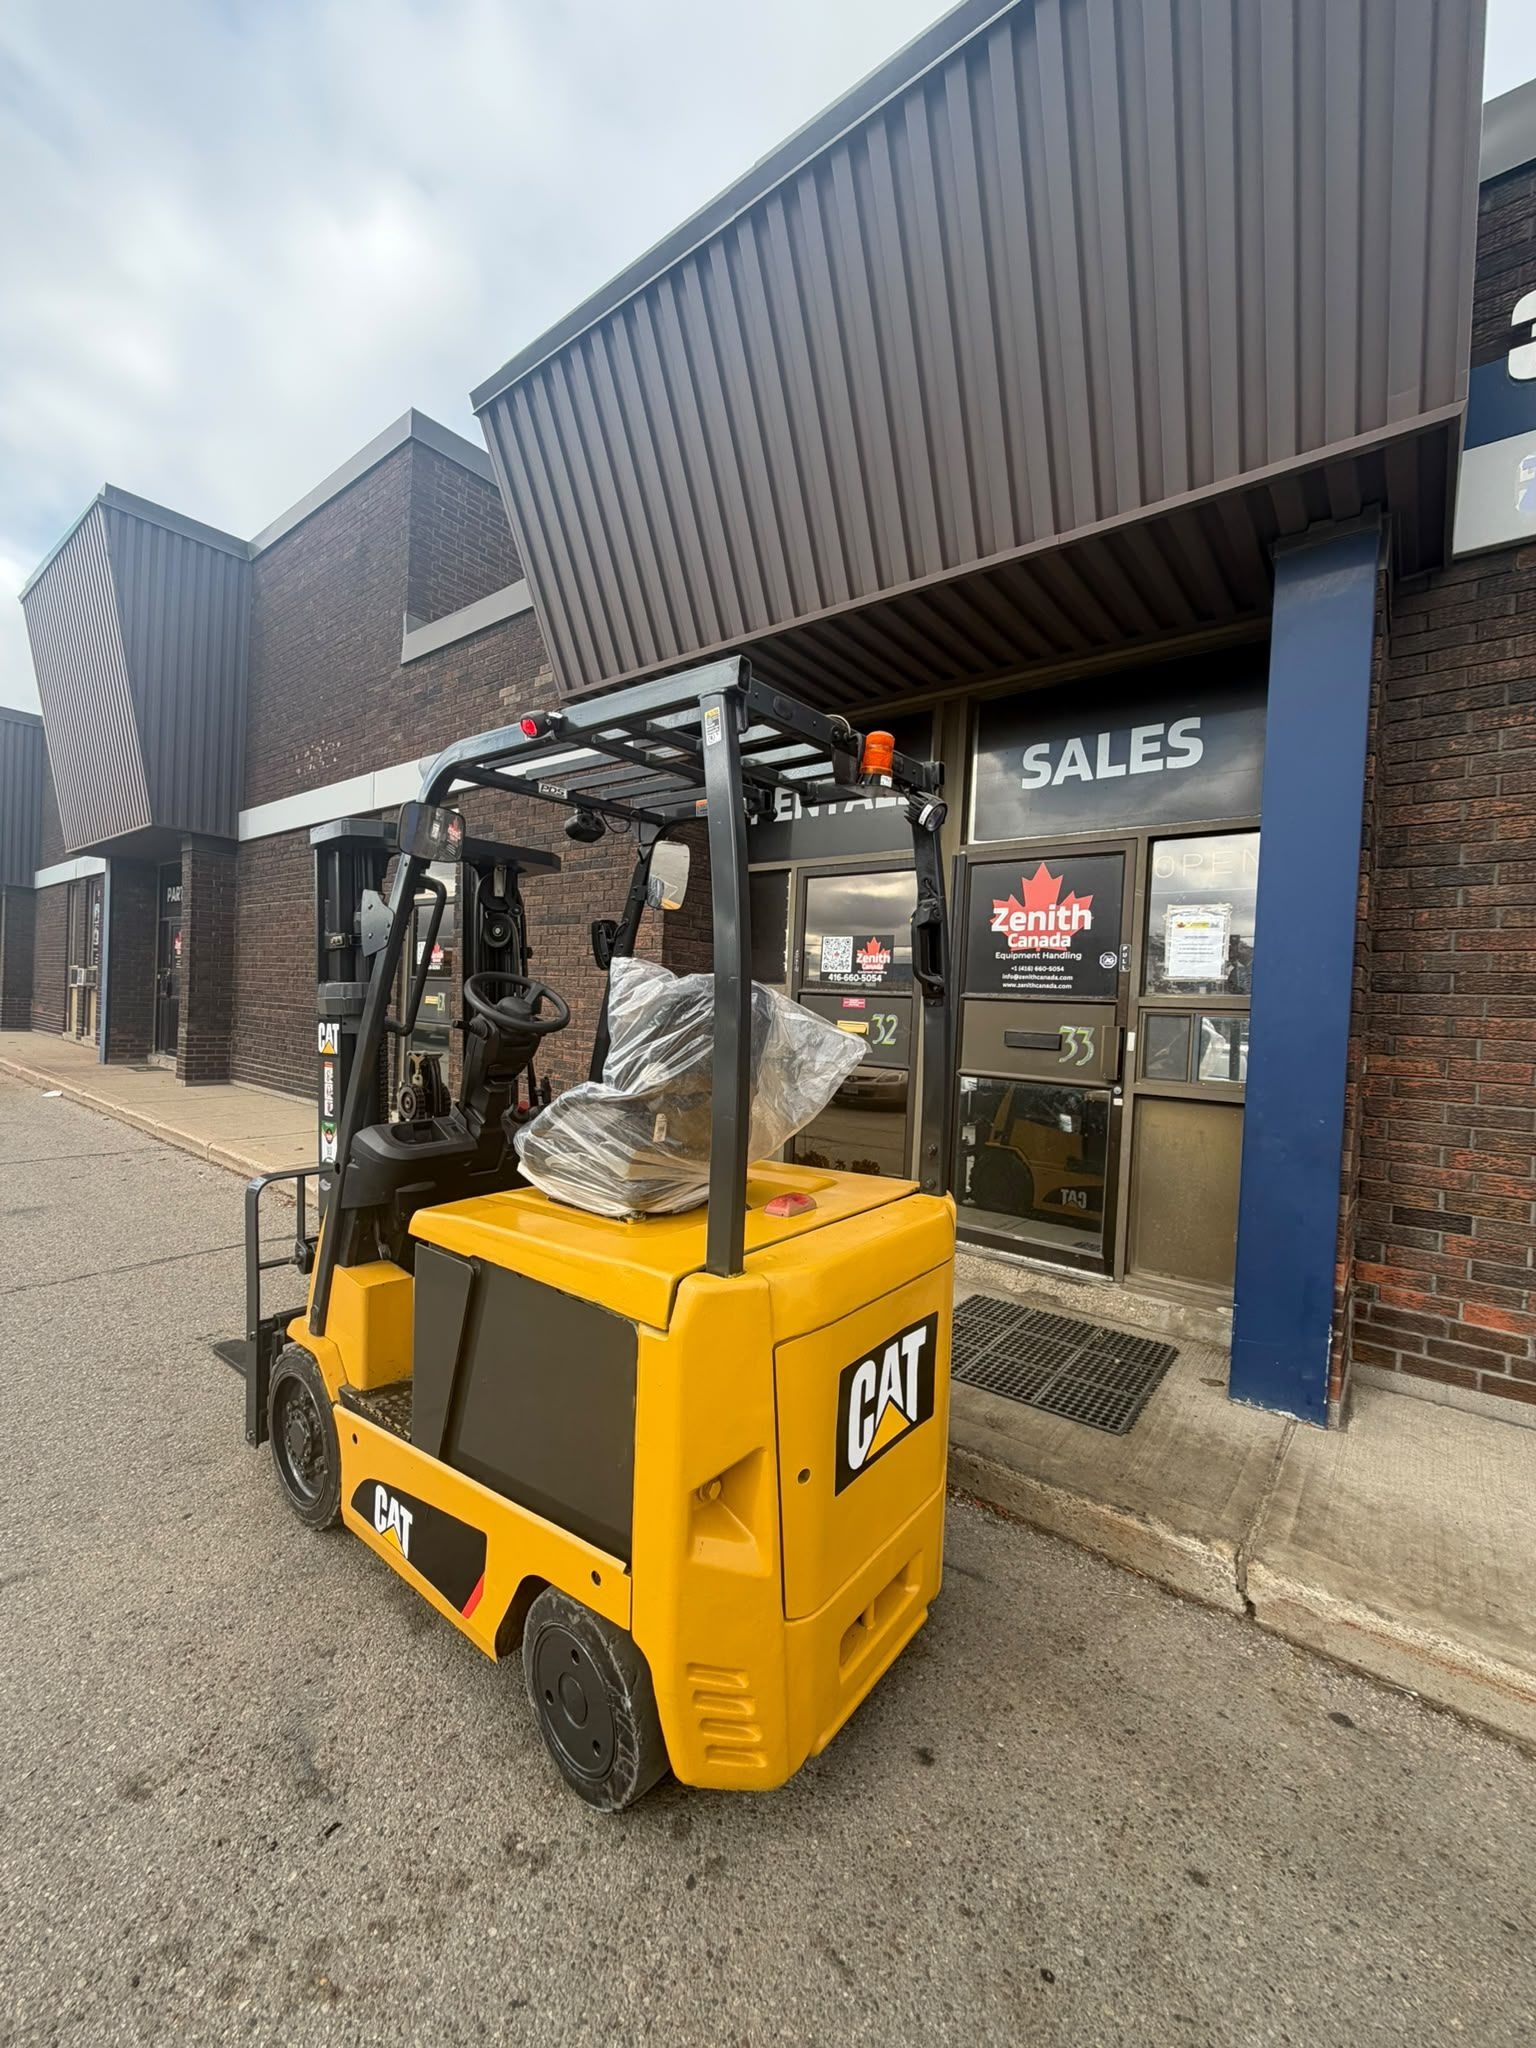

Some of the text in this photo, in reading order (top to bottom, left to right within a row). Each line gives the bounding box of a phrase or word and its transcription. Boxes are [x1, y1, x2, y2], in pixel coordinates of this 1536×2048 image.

[1021, 717, 1204, 790] SALES
[991, 904, 1092, 932] Zenith
[1008, 932, 1071, 948] Canada
[856, 952, 891, 964] Zenith
[995, 952, 1082, 961] Equipment Handling
[828, 973, 882, 982] 416-660-5054
[318, 1022, 339, 1054] CAT
[871, 1013, 898, 1045] 32
[1058, 1025, 1095, 1066] 33
[848, 1325, 927, 1471] CAT
[374, 1484, 413, 1559] CAT
